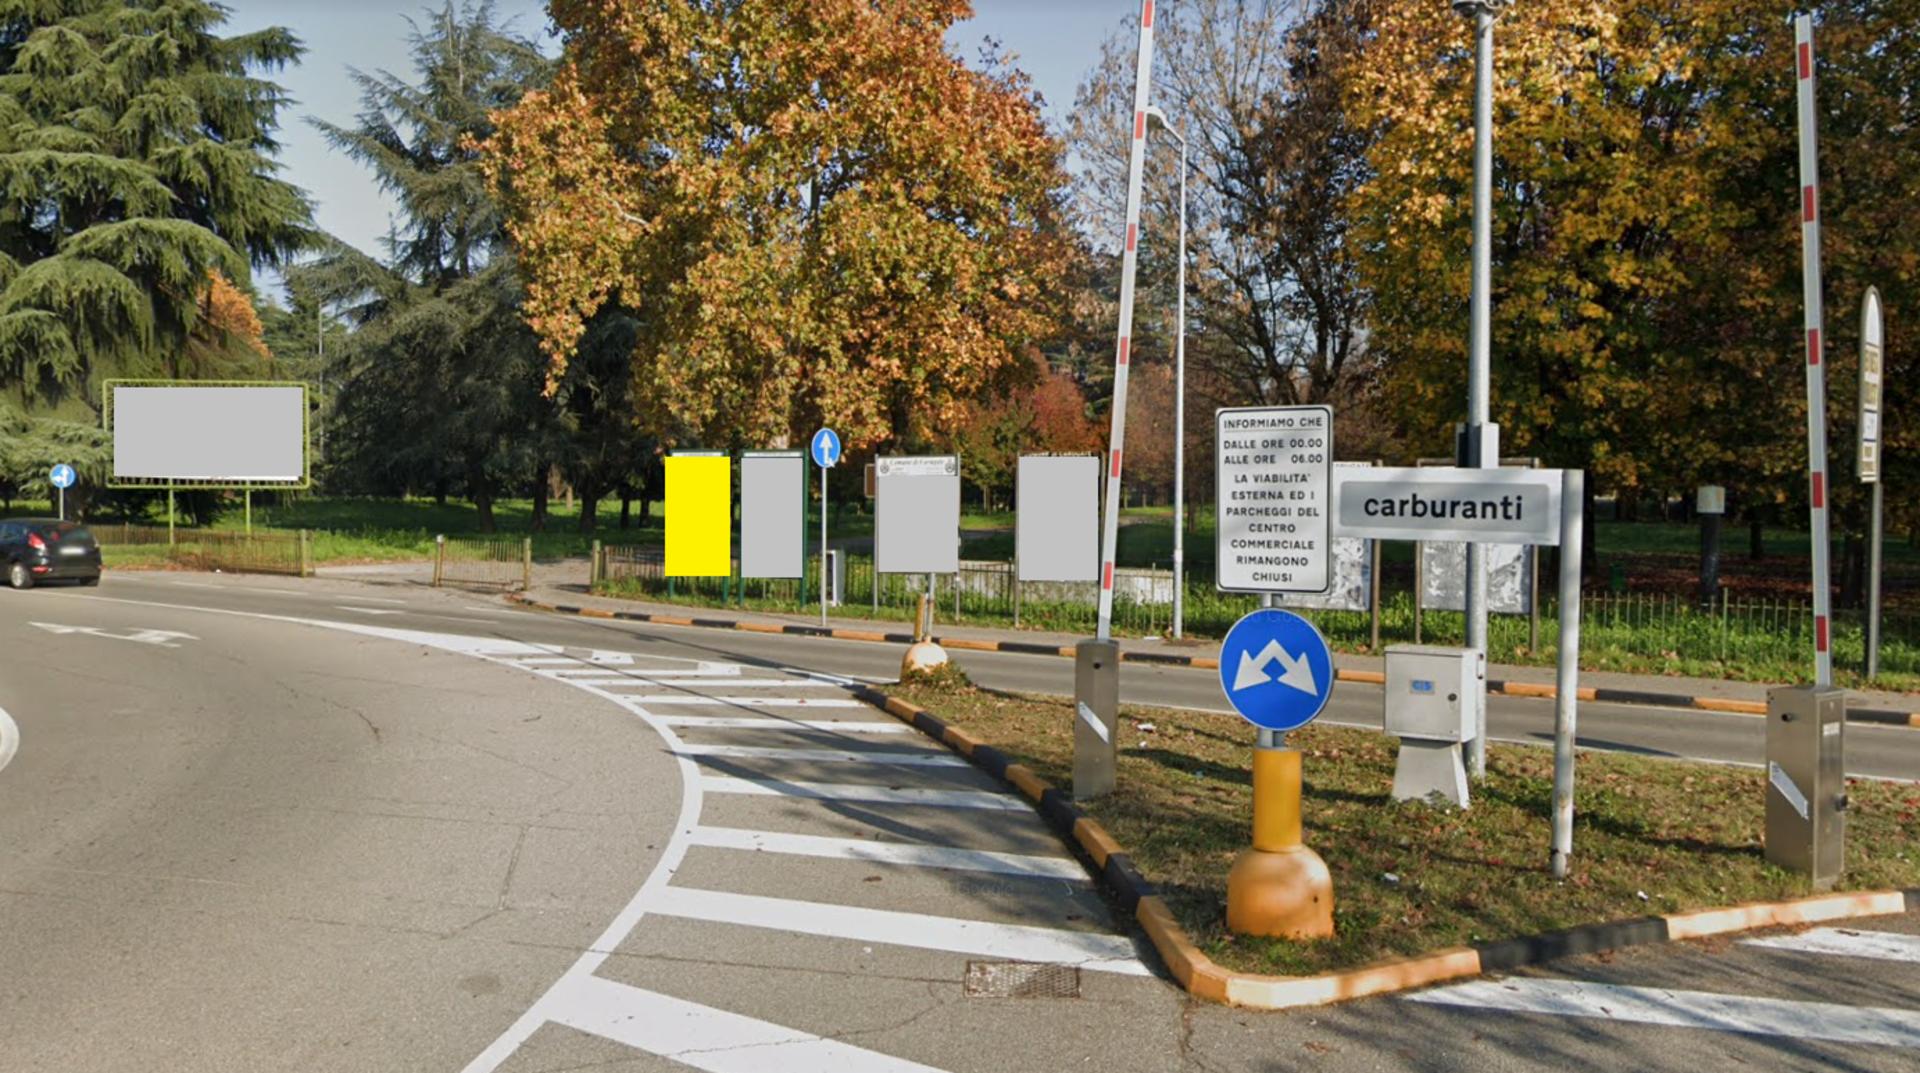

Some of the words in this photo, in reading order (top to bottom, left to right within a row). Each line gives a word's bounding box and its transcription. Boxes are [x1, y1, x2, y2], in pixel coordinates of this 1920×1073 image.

[1223, 418, 1295, 429] INFORMIAMO
[1299, 417, 1323, 427] CHE
[1223, 440, 1257, 450] DALLE
[1261, 439, 1285, 449] ORE
[1289, 438, 1323, 448] 00.00
[1224, 455, 1249, 465] ALLE
[1253, 454, 1276, 464] ORE
[1291, 453, 1323, 464] 06.00
[1234, 474, 1248, 483] LA
[1231, 490, 1285, 501] ESTERNA
[1289, 490, 1306, 500] ED
[1310, 490, 1315, 500] I
[1226, 507, 1292, 517] PARCHEGGI
[1297, 507, 1320, 517] DEL
[1363, 493, 1523, 520] carburanti
[1249, 523, 1297, 533] CENTRO
[1231, 539, 1315, 550] COMMERCIALE
[1236, 556, 1309, 567] RIMANGONO
[1252, 572, 1292, 582] CHIUSI
